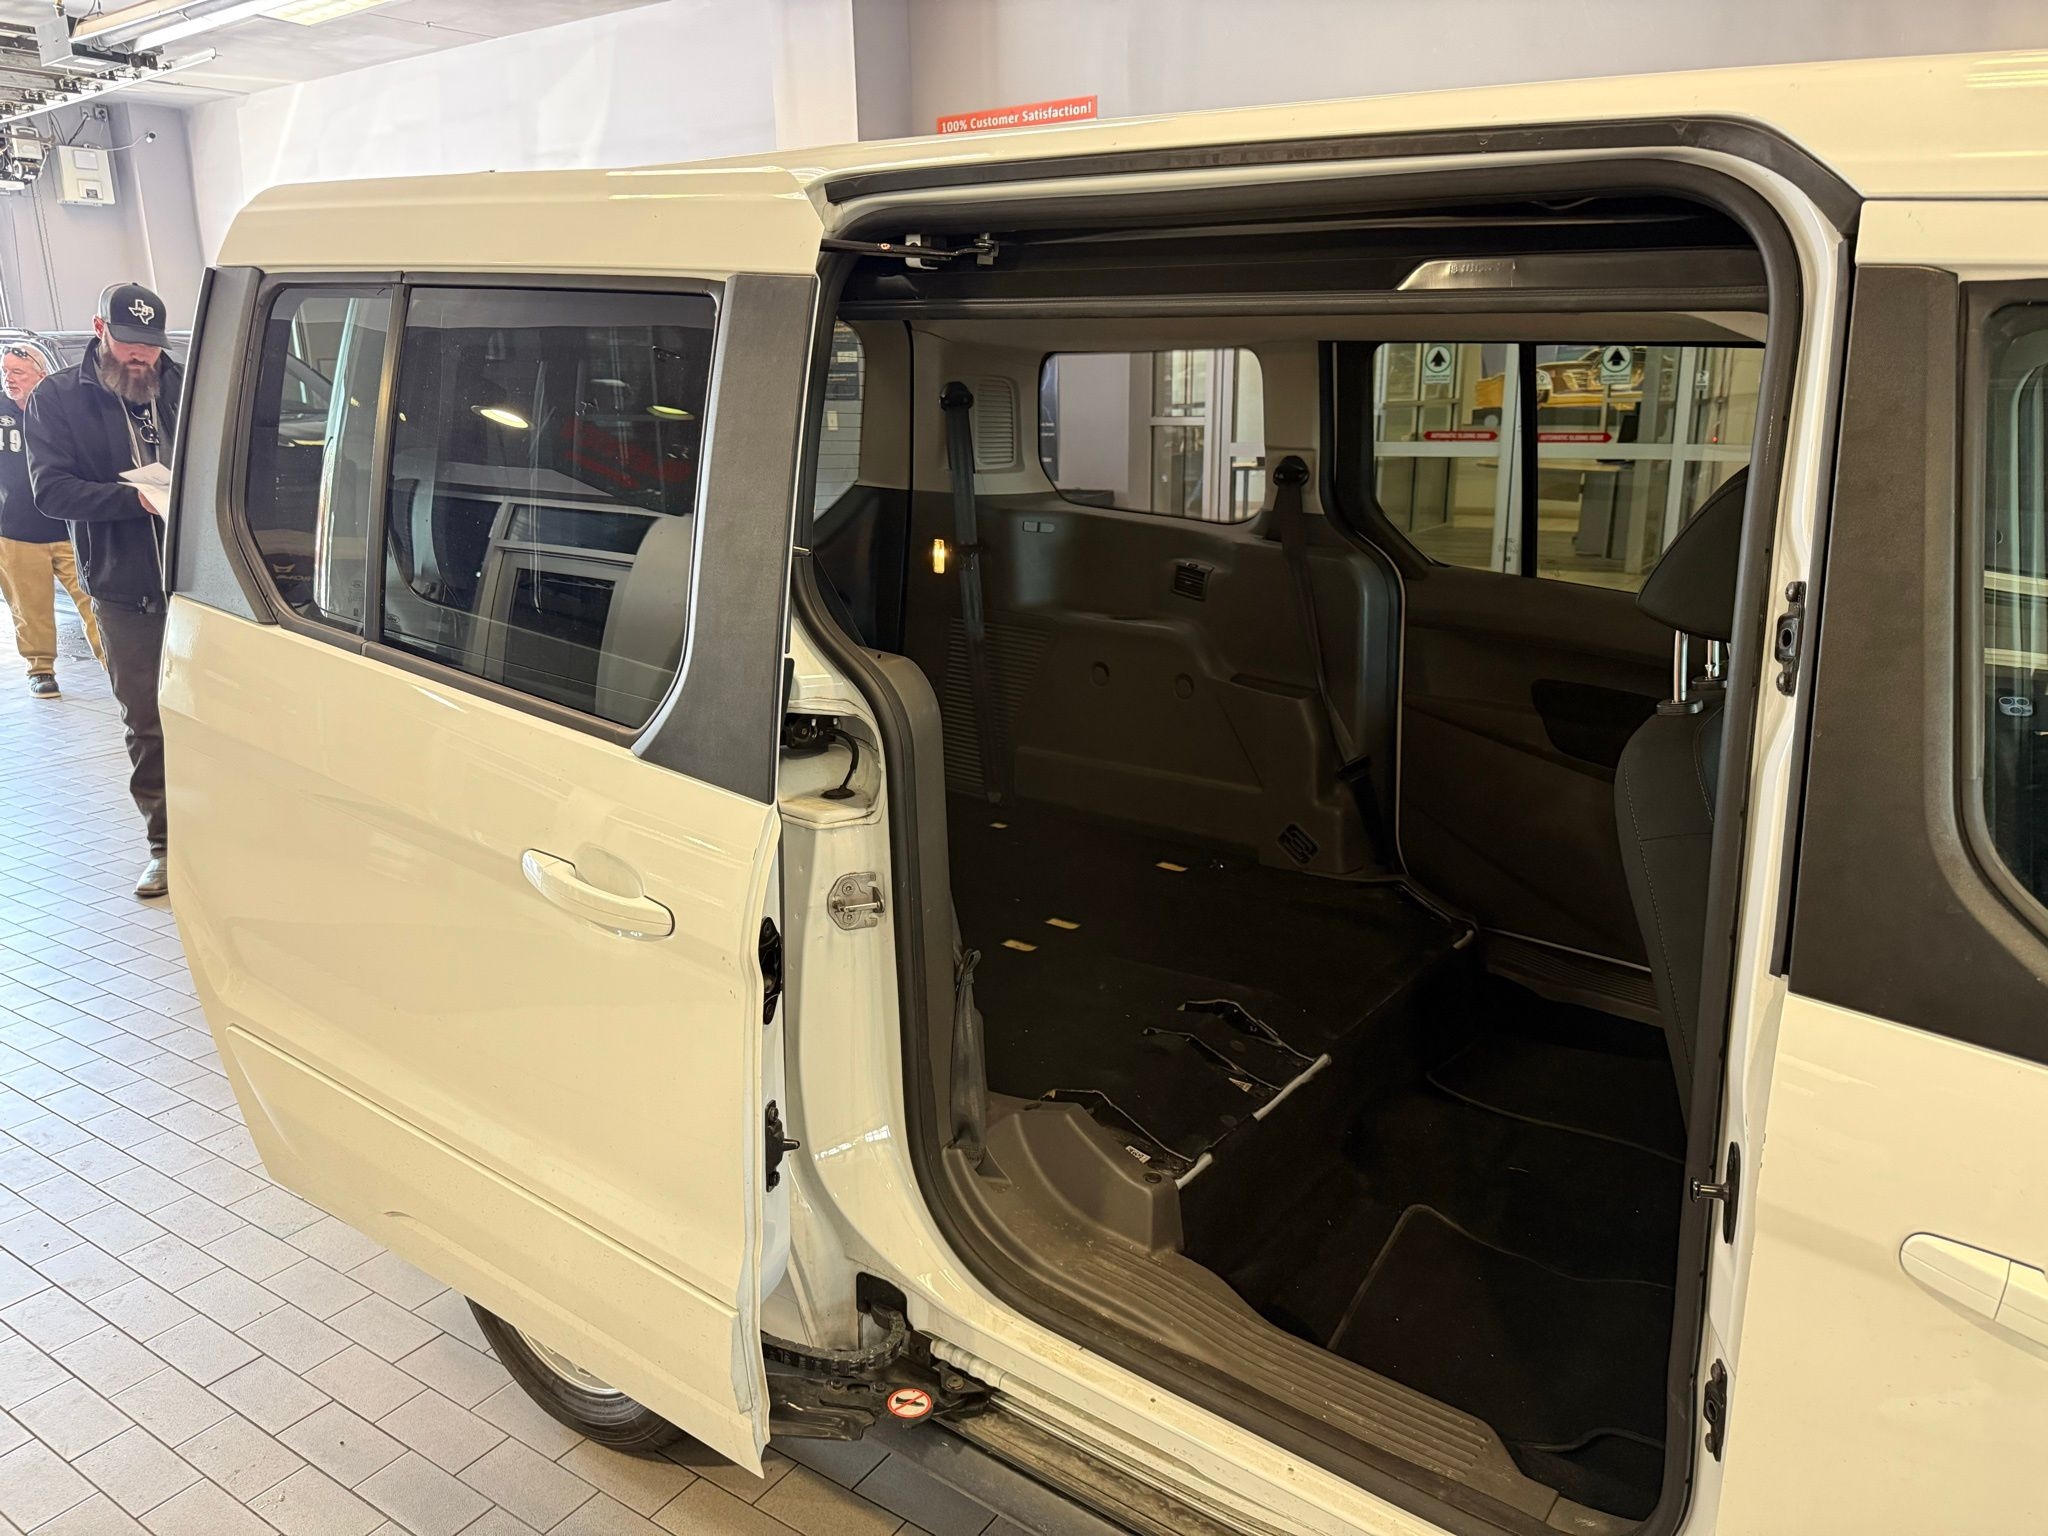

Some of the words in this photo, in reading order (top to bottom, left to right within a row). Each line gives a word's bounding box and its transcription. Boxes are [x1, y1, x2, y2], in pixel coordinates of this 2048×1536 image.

[942, 119, 968, 133] 100%
[970, 114, 1019, 129] Customer
[1022, 101, 1092, 122] Satisfaction!
